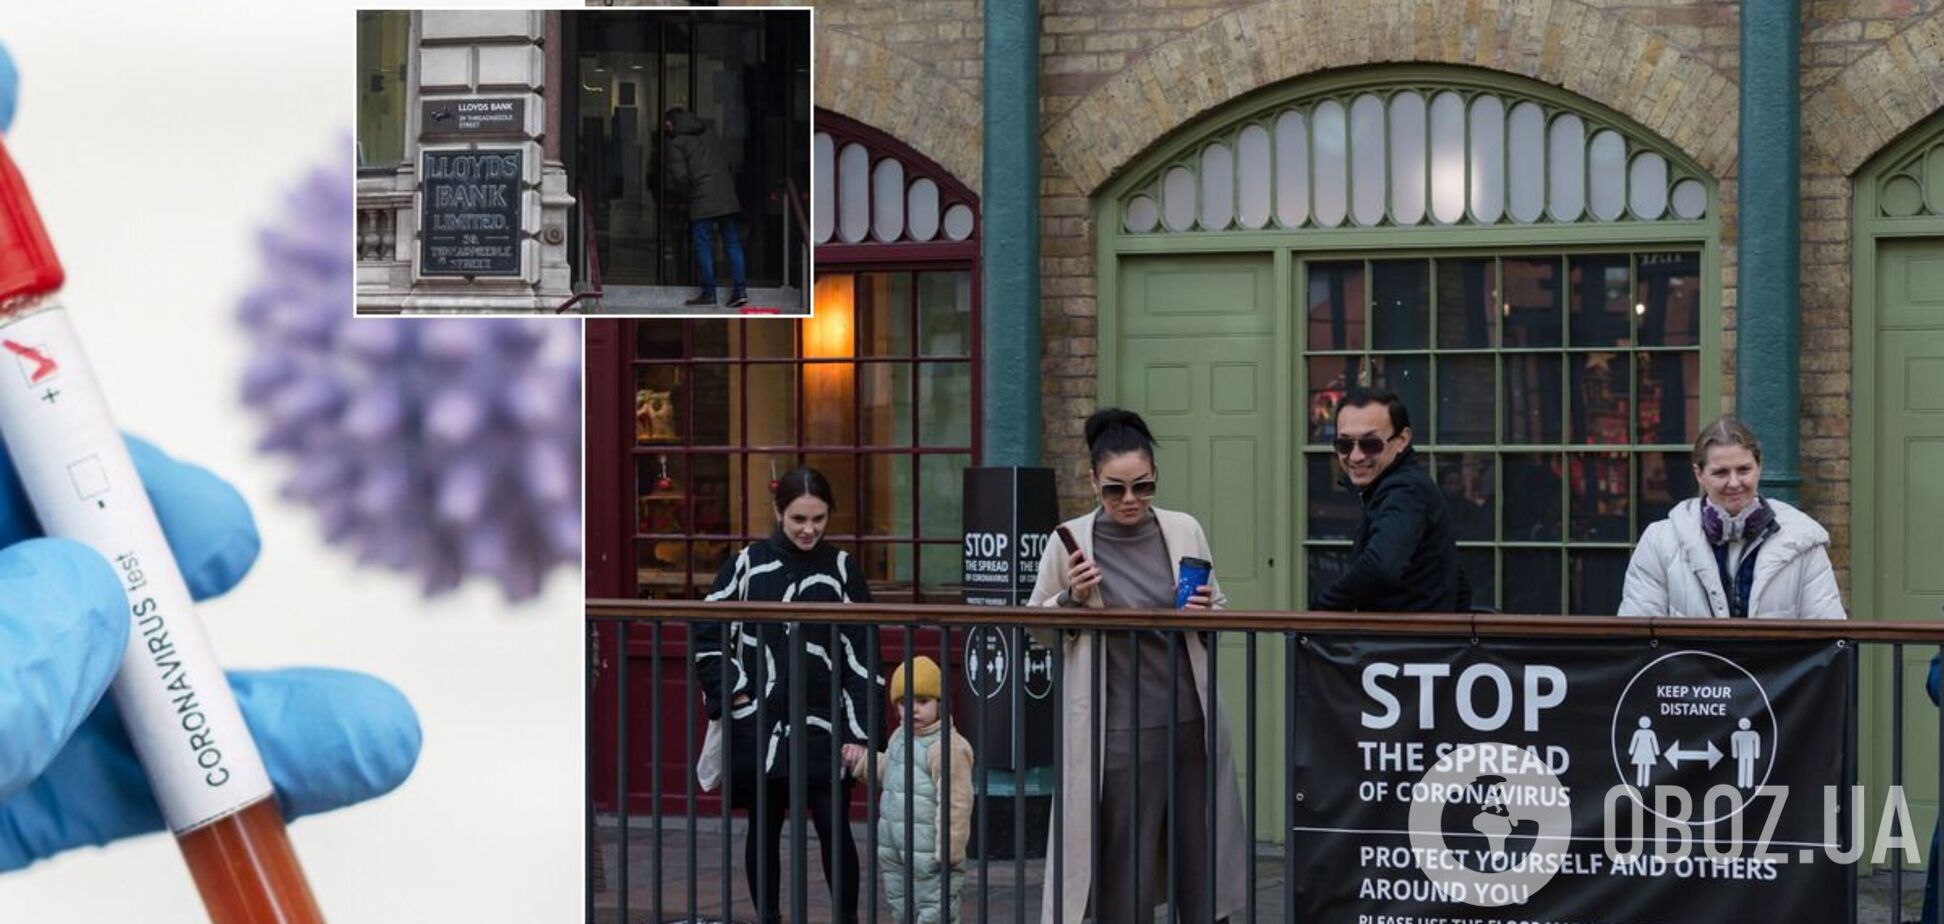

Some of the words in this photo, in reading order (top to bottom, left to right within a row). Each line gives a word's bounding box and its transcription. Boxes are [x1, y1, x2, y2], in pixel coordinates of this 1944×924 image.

[458, 103, 488, 111] LLOYDS
[491, 103, 513, 111] BANK
[425, 156, 518, 178] LLOYDS
[436, 185, 507, 208] BANK
[965, 533, 1008, 557] STOP
[115, 549, 148, 592] test
[965, 560, 977, 571] THE
[978, 560, 1009, 572] SPREAD
[132, 596, 230, 788] CORONAVIRUS
[1360, 662, 1569, 732] STOP
[1656, 685, 1687, 699] KEEP
[1691, 686, 1732, 700] YOUR
[1660, 703, 1727, 717] DISTANCE
[1358, 741, 1425, 773] THE
[1435, 743, 1570, 776] SPREAD
[1358, 781, 1389, 803] OF
[1395, 782, 1571, 808] CORONAVIRUS
[1360, 846, 1469, 870] PROTECT
[1475, 850, 1603, 875] YOURSELF
[1610, 855, 1668, 877] AND
[1674, 857, 1777, 880] OTHERS
[1359, 878, 1467, 904] AROUND
[1473, 882, 1530, 905] YOU
